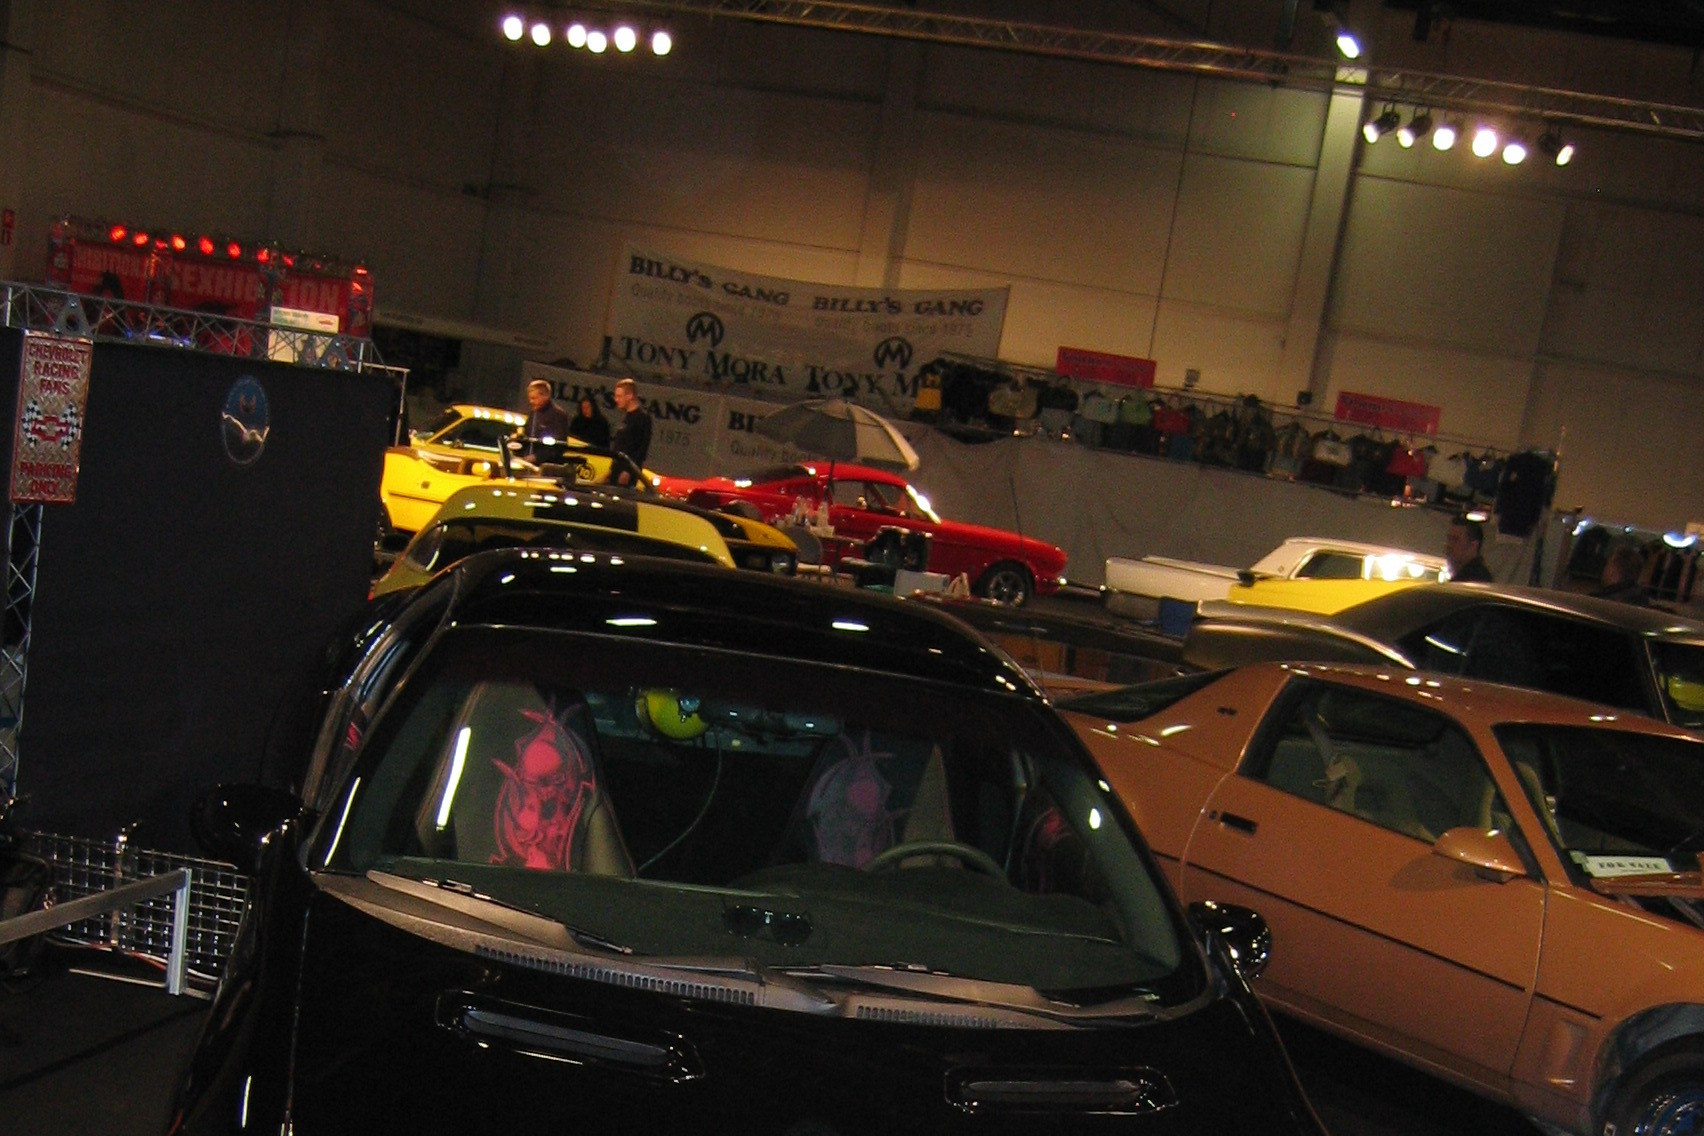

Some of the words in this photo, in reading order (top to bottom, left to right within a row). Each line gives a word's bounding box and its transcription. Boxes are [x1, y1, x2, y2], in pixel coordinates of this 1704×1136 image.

[722, 282, 789, 306] GANG
[914, 299, 984, 316] GANG
[28, 343, 86, 362] CHEVROLET
[621, 336, 695, 369] TONY
[704, 351, 786, 384] MORA
[33, 361, 79, 380] RACING
[39, 379, 70, 395] FANS
[20, 461, 72, 478] PARKING
